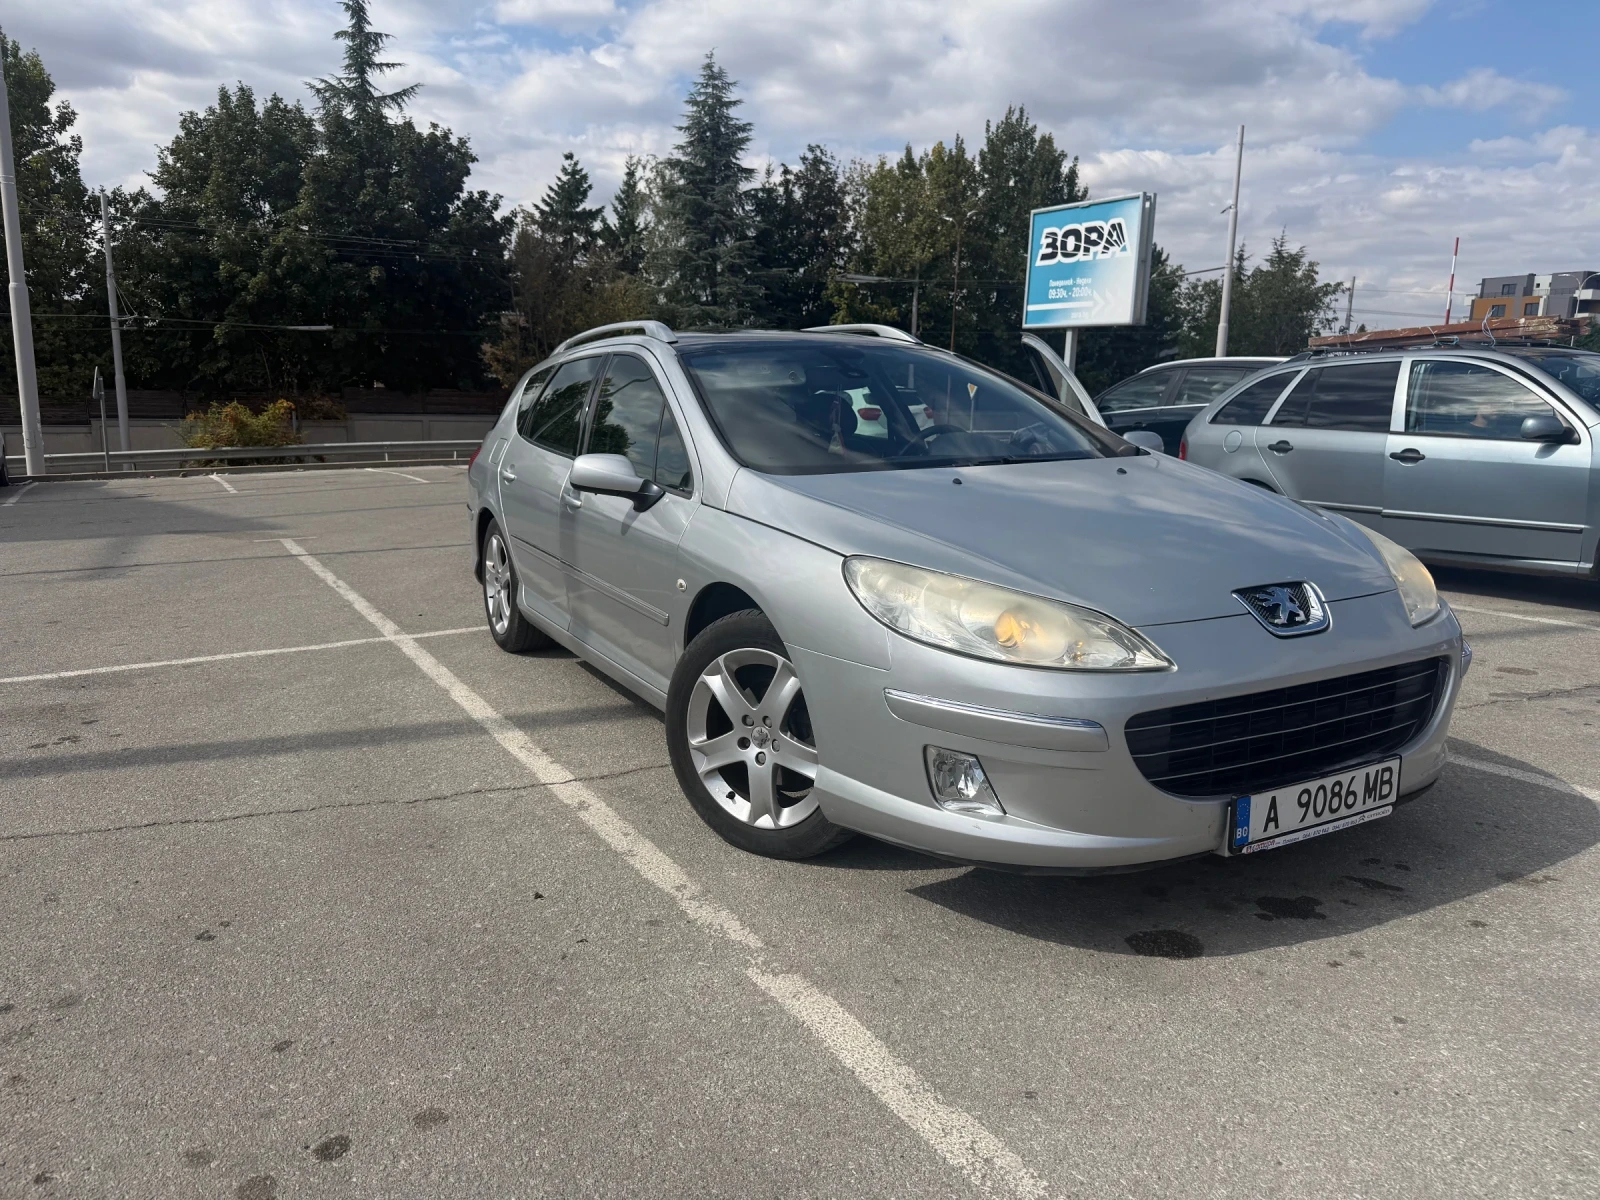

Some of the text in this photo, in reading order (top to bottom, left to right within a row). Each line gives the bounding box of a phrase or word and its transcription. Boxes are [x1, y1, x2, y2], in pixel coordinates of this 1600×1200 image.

[1037, 219, 1130, 265] ЗОРА
[1263, 767, 1393, 832] A 9086 MB
[1236, 827, 1248, 839] BG
